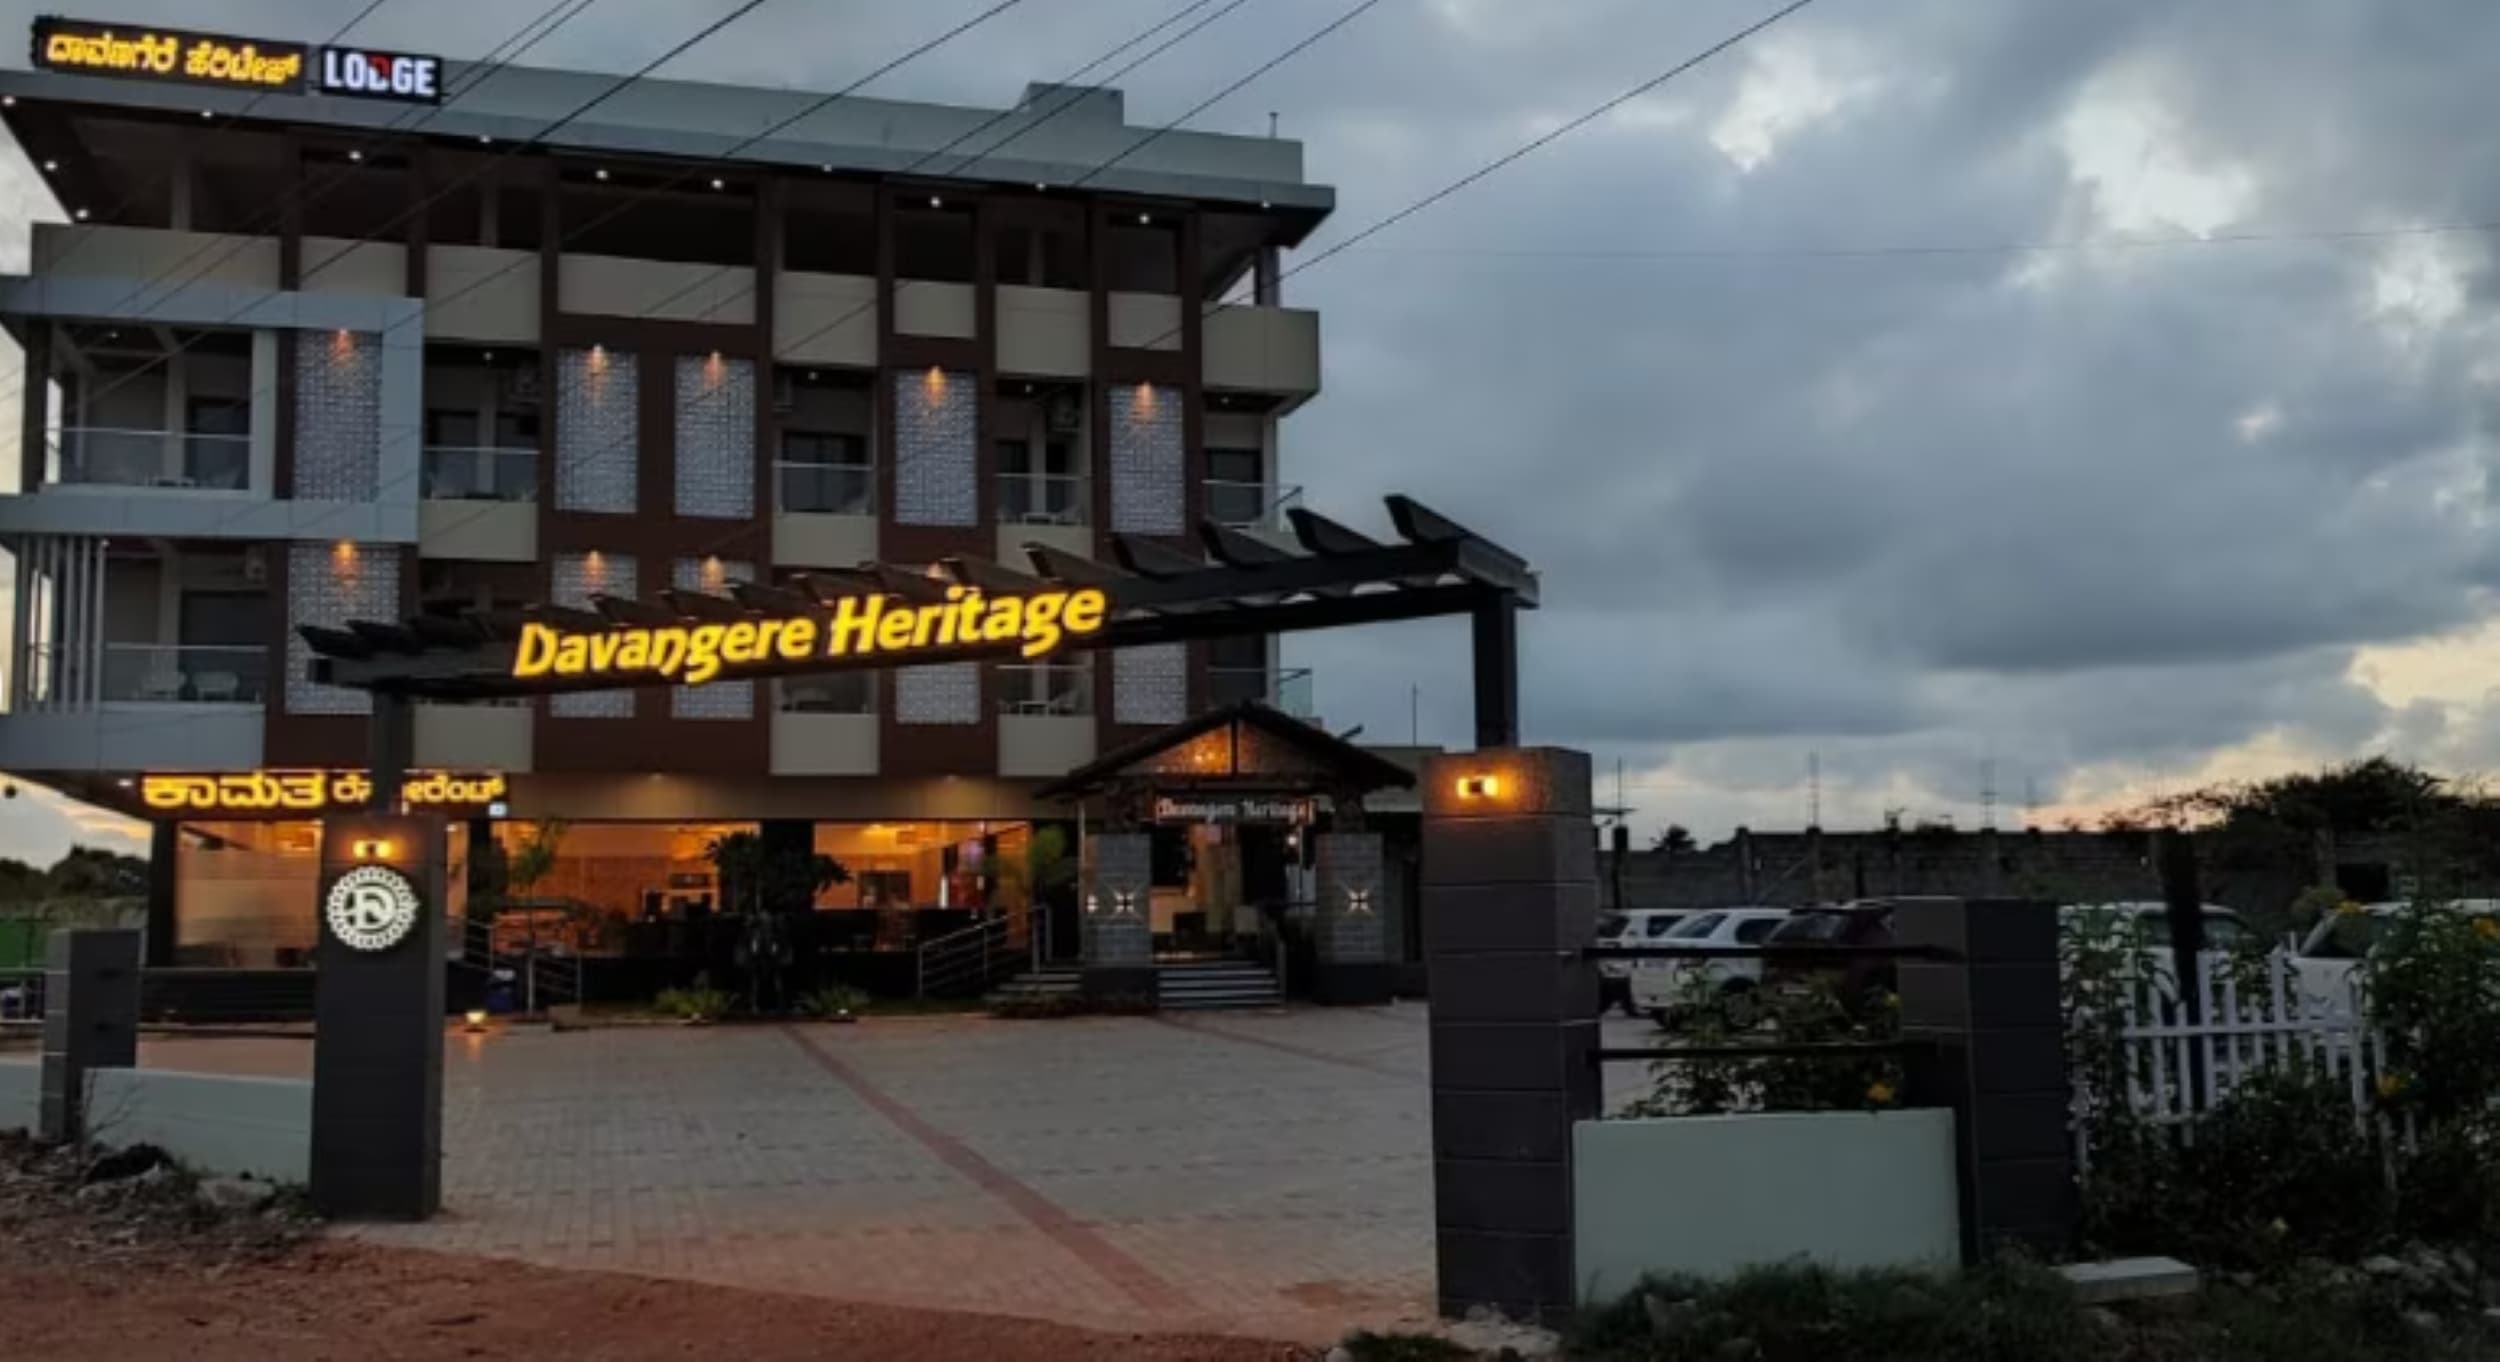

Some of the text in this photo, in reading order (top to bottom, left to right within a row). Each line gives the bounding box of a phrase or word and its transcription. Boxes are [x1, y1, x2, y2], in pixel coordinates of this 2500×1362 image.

[325, 51, 435, 95] LODGE
[513, 584, 1106, 686] Davangere Heritage
